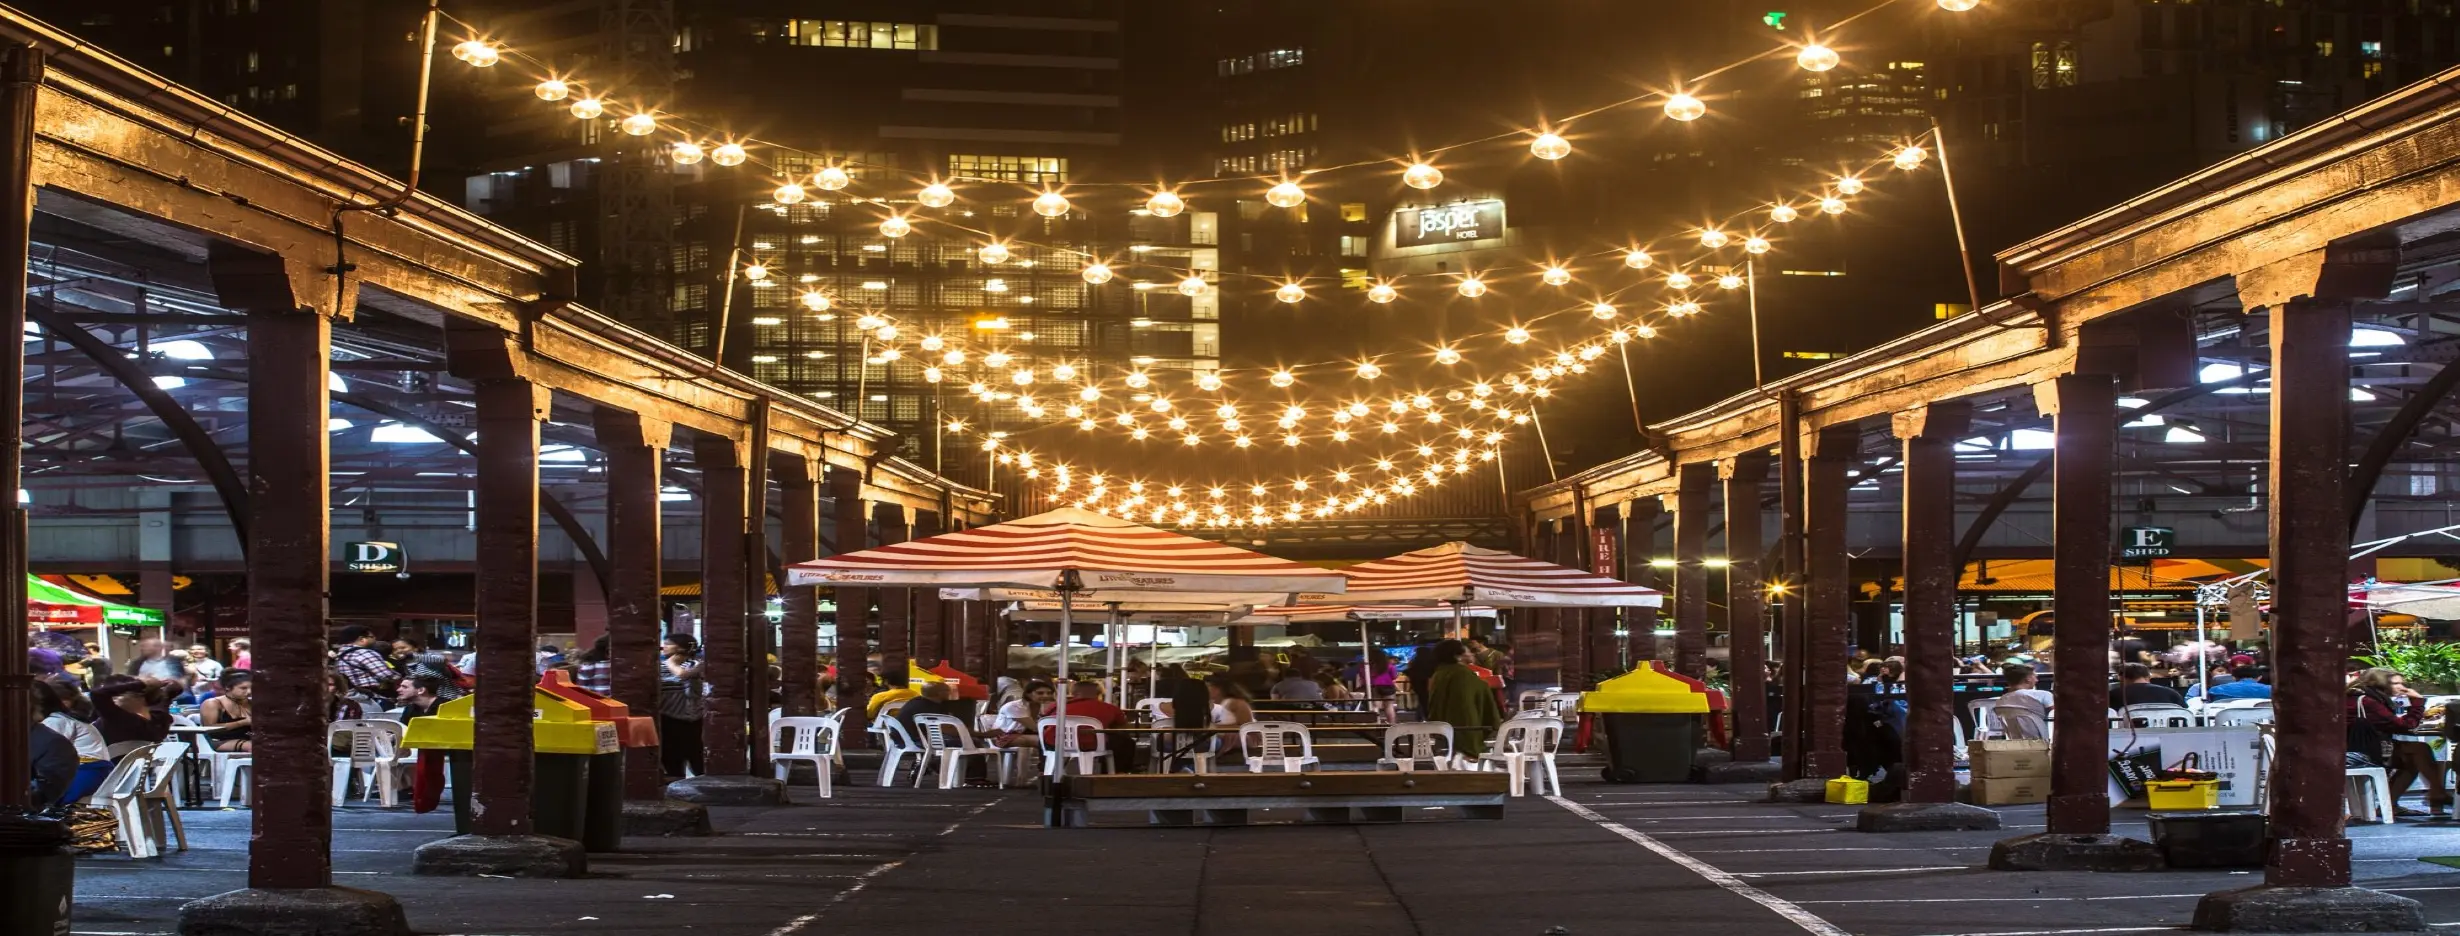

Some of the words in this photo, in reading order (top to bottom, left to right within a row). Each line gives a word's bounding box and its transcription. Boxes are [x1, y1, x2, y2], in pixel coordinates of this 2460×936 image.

[1456, 230, 1478, 239] HOTEL
[2132, 528, 2163, 547] E
[354, 543, 388, 562] D
[2124, 548, 2170, 557] SHED
[348, 562, 398, 571] SHED
